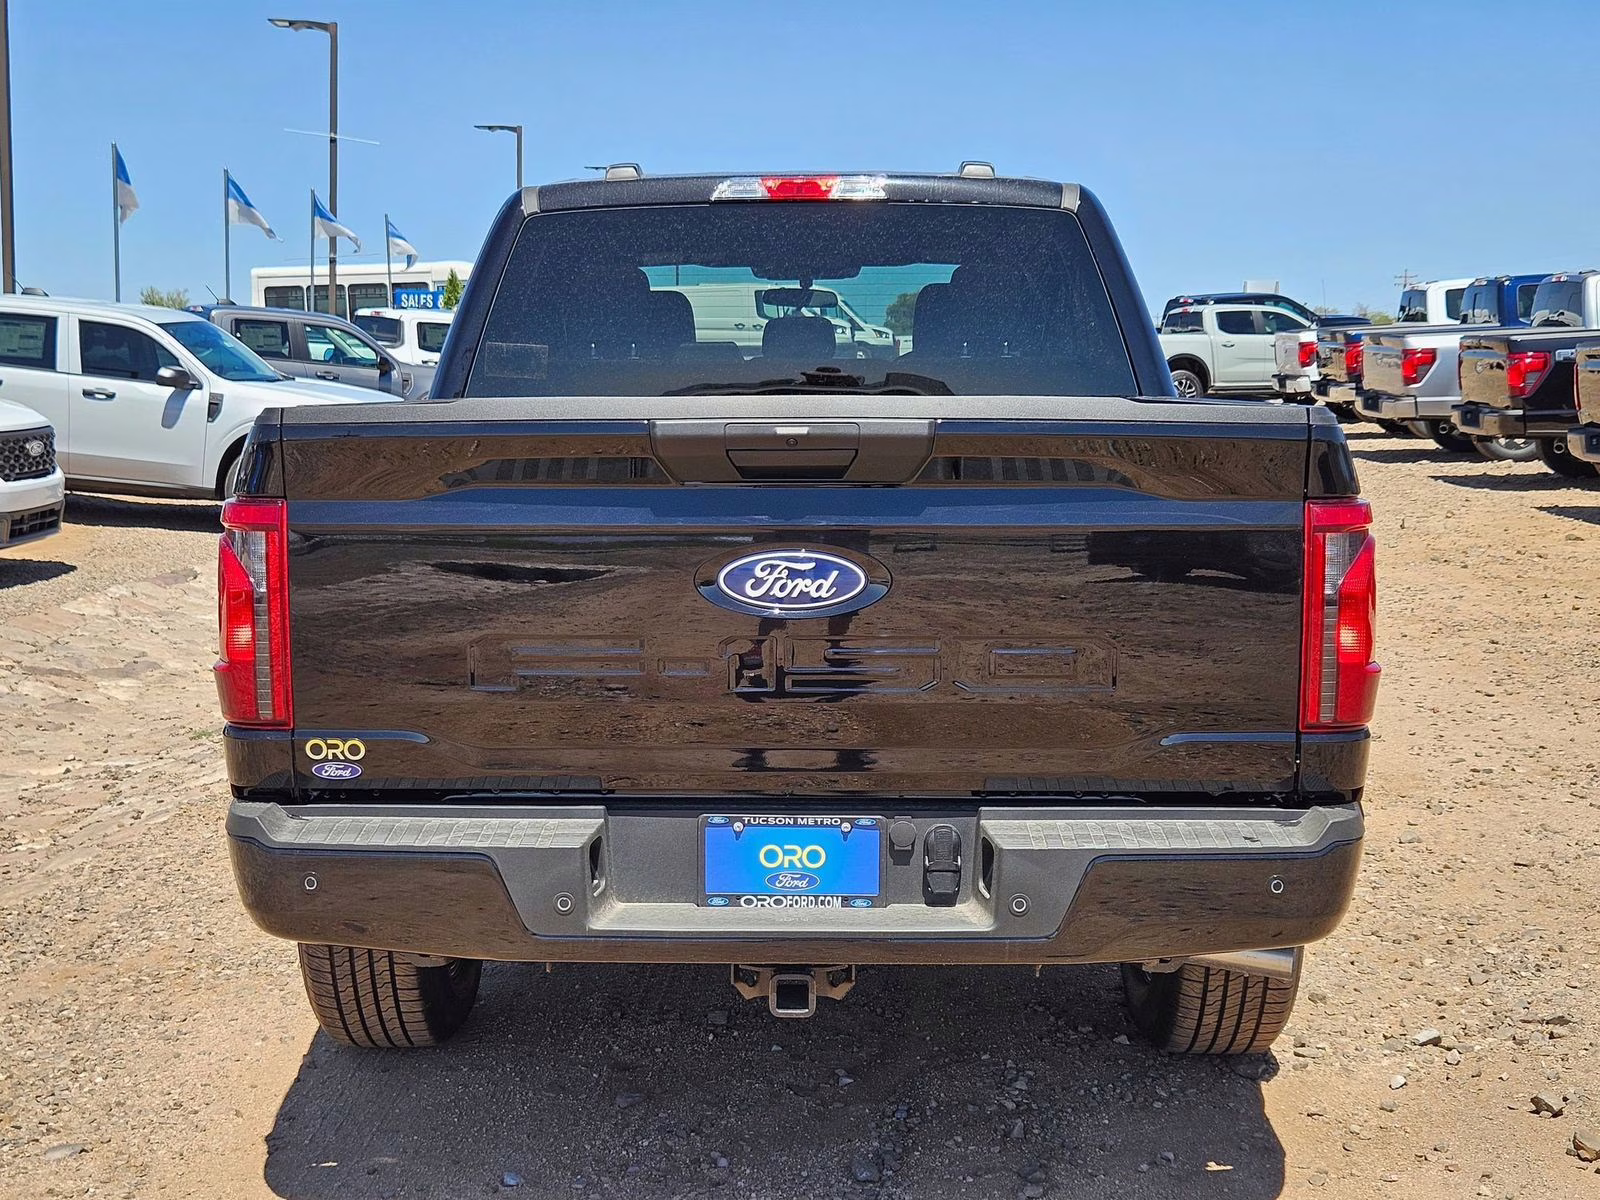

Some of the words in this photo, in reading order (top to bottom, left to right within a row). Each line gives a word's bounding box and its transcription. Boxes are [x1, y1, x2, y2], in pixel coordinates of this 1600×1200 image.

[401, 293, 434, 308] SALES
[745, 560, 840, 598] Ford
[468, 634, 1117, 691] F-150
[305, 738, 366, 761] ORO
[322, 764, 352, 777] Ford
[742, 817, 794, 825] TUCSON
[797, 817, 841, 826] METRO
[759, 844, 827, 869] ORO
[775, 873, 809, 888] Ford
[740, 895, 842, 909] OROFORD.COM
